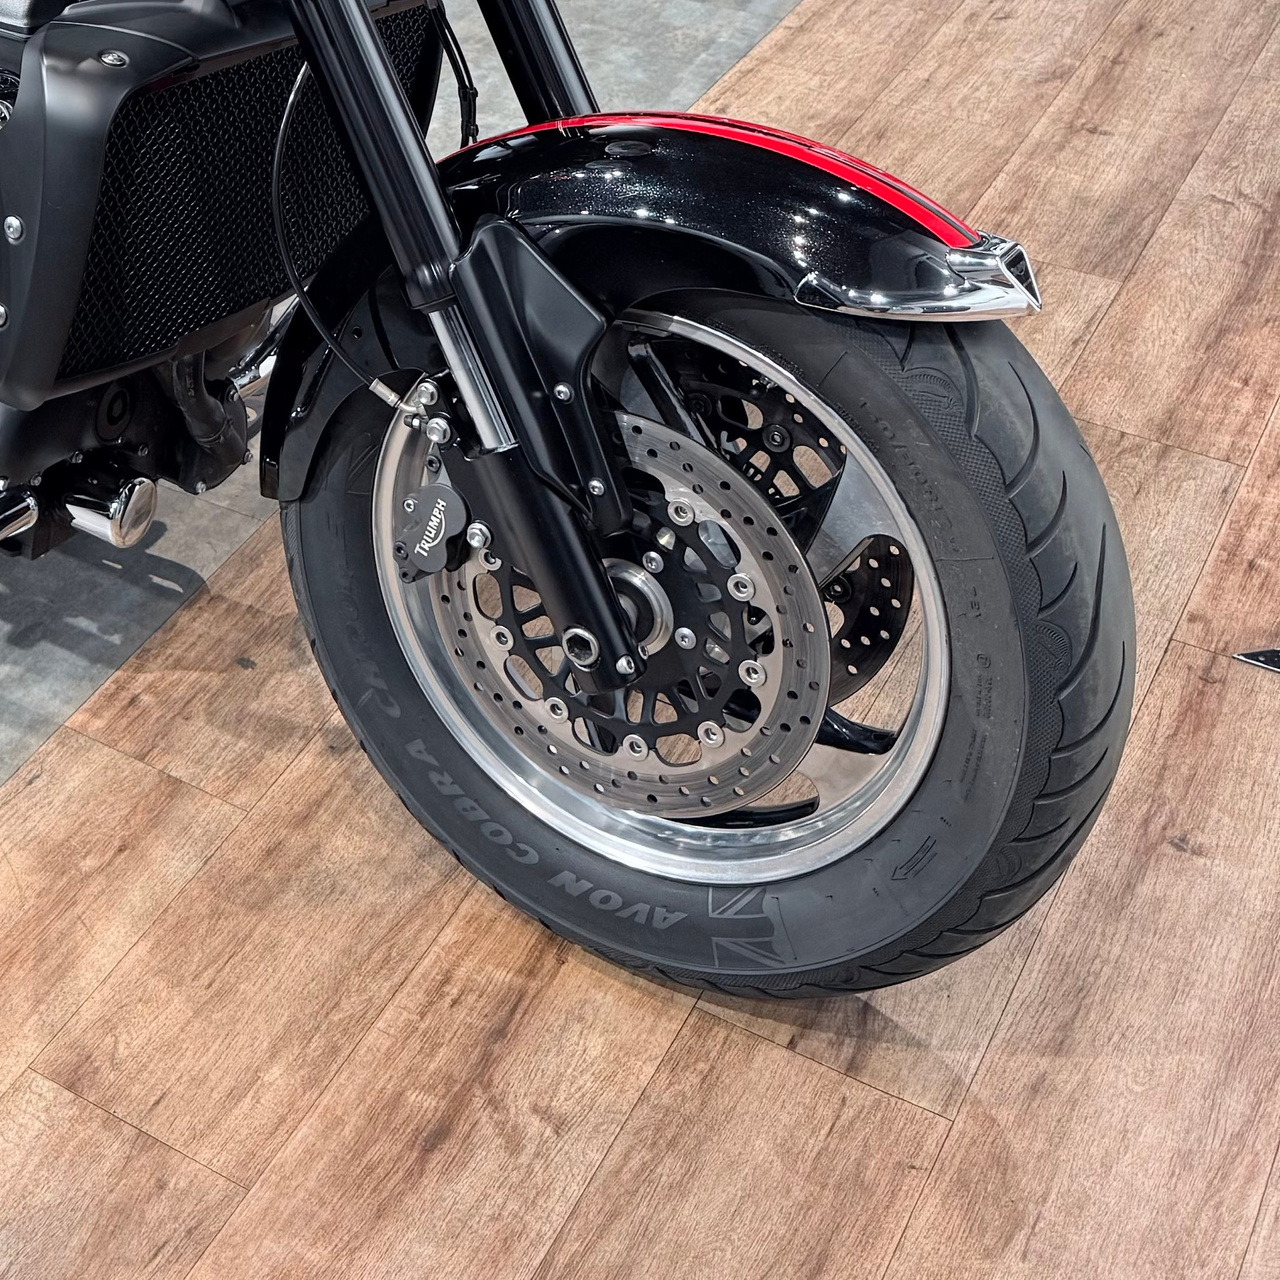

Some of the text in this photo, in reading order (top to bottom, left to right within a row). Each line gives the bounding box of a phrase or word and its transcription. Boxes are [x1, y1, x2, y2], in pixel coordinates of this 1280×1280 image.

[414, 498, 447, 557] TRIUMPH
[404, 738, 539, 867] COBRA
[547, 870, 692, 931] AVON
